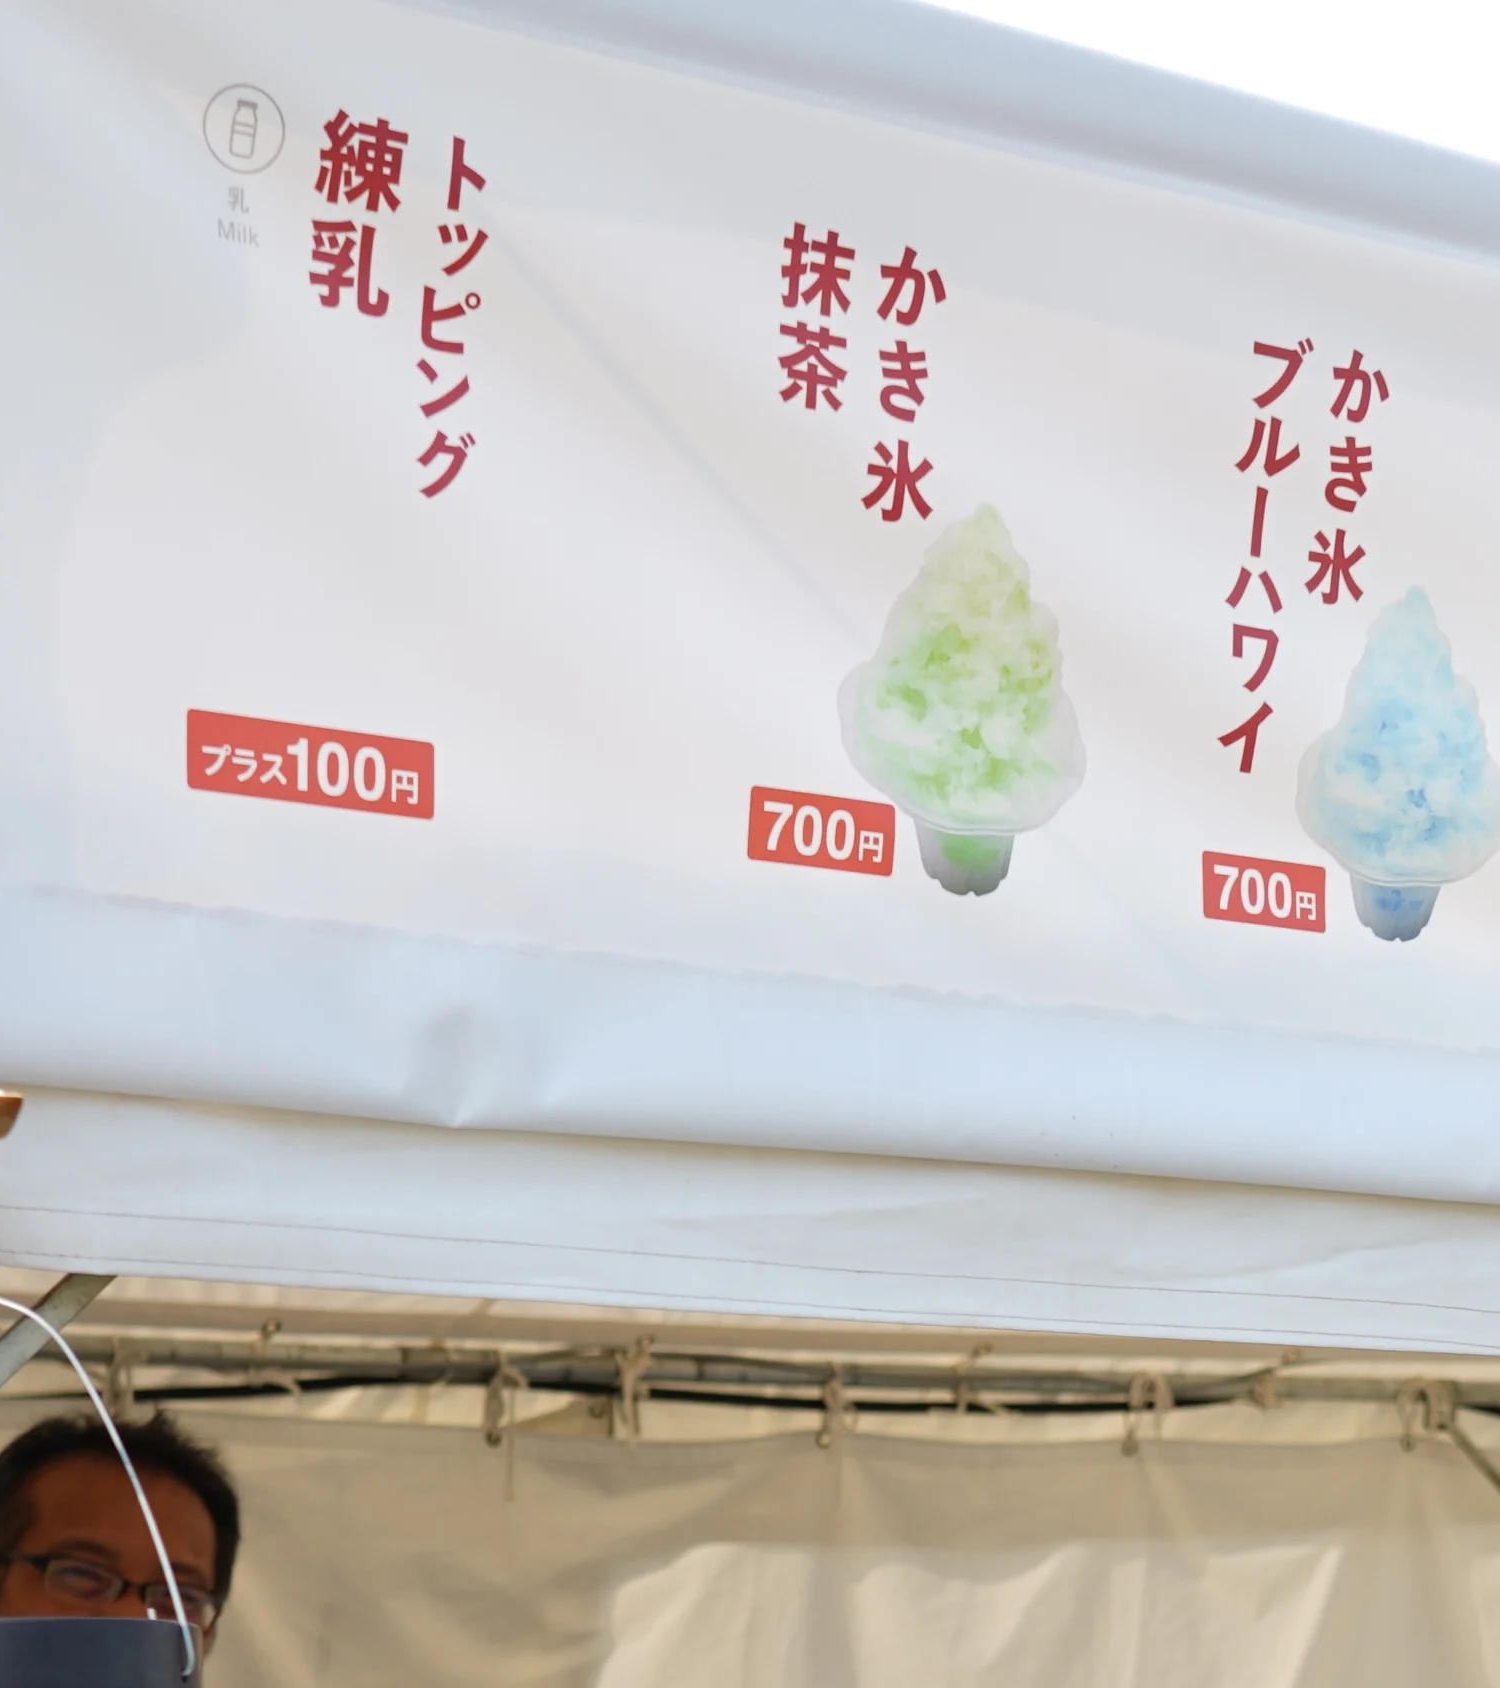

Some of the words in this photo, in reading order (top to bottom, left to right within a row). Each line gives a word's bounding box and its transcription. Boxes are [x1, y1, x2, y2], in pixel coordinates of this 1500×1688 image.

[217, 218, 261, 247] Milk
[309, 108, 409, 318] 練乳
[414, 134, 489, 498] トッピング
[778, 221, 855, 413] 抹茶
[861, 245, 947, 522] かき氷
[1217, 337, 1314, 773] ブルーハワイ
[1304, 349, 1389, 605] かき氷
[201, 738, 419, 804] プラス100円
[762, 800, 884, 864] 700円
[1213, 865, 1317, 922] 700円
